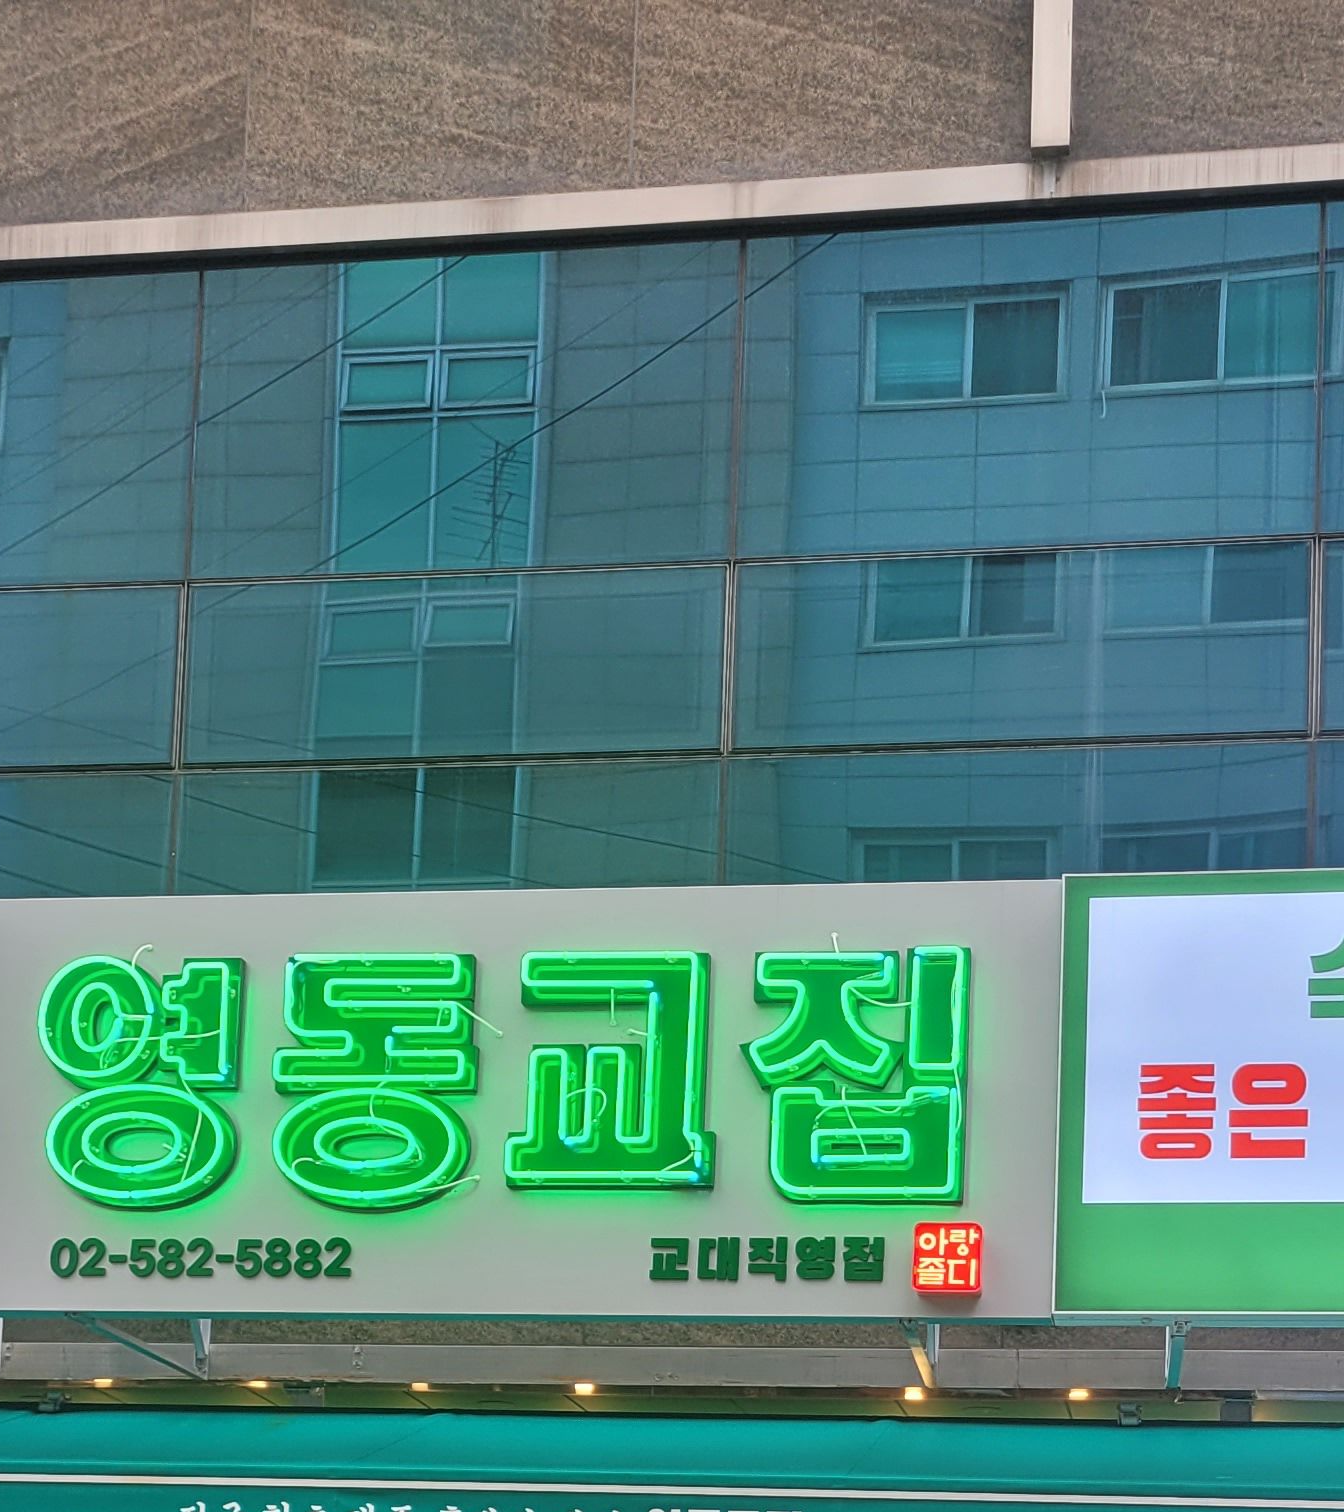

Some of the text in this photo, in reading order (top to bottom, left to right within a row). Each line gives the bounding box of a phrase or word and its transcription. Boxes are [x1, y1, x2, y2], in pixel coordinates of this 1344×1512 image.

[37, 943, 973, 1211] 영동교집
[1134, 1060, 1311, 1161] 좋은
[48, 1236, 353, 1280] 02-582-5882
[649, 1236, 885, 1282] 교대직영점
[919, 1228, 979, 1256] 아랑
